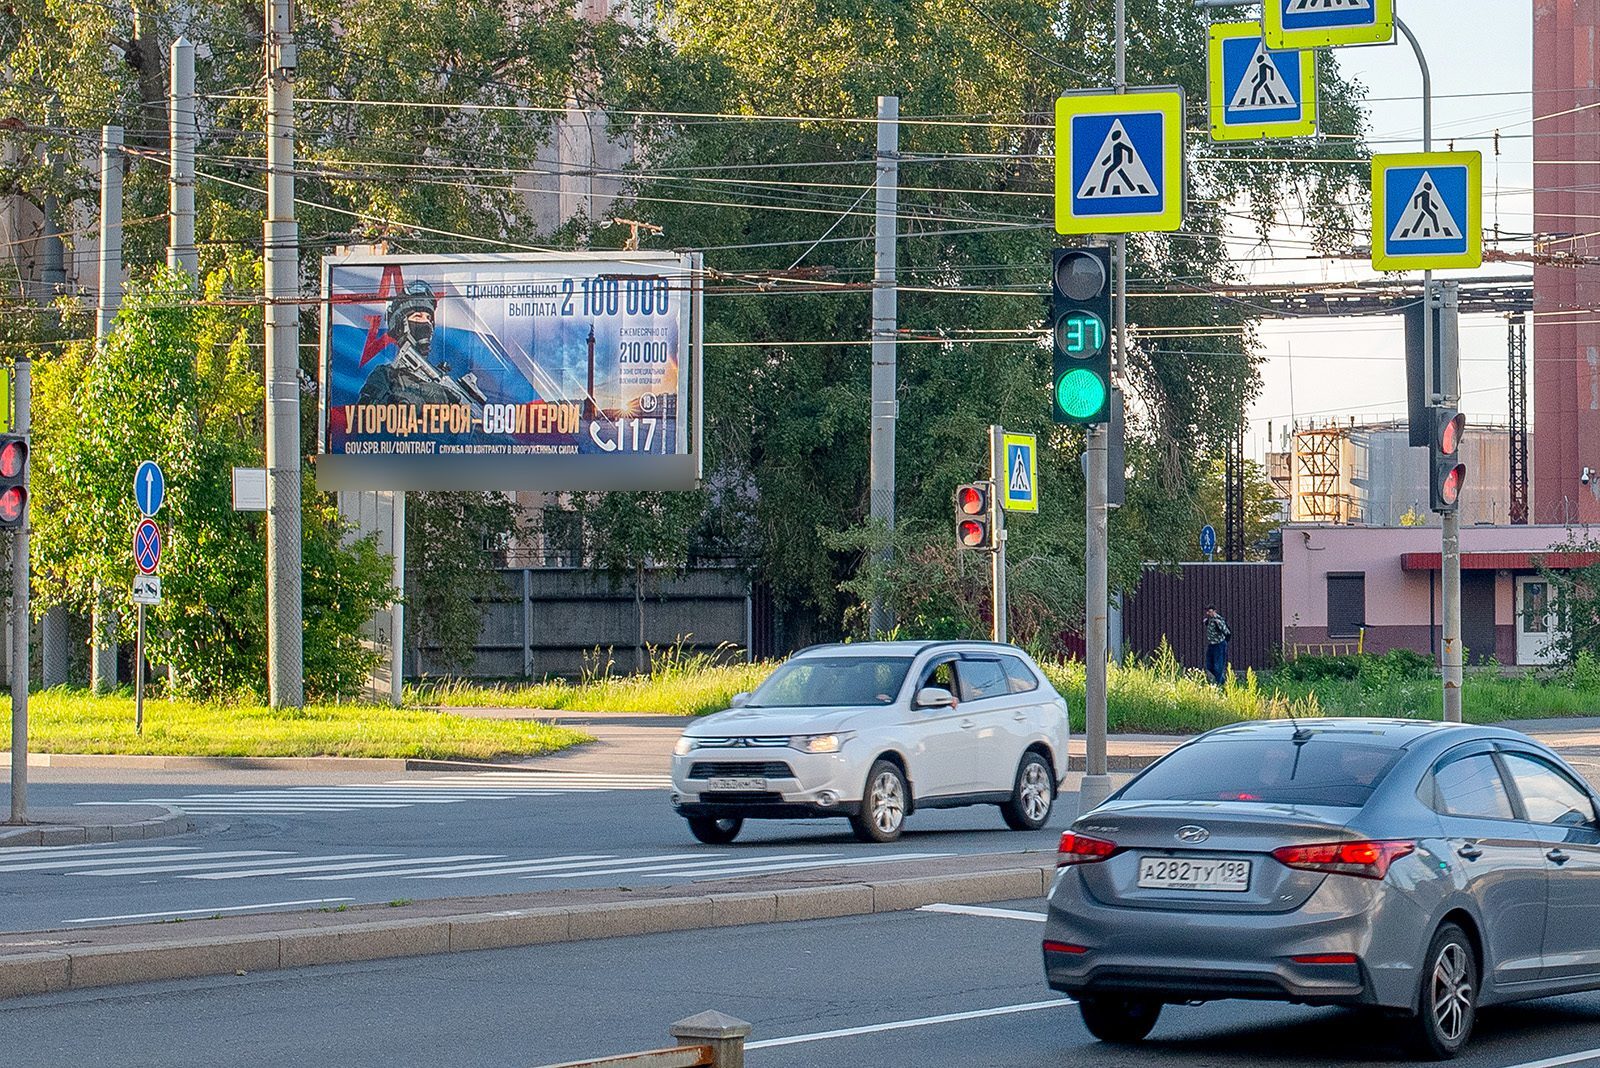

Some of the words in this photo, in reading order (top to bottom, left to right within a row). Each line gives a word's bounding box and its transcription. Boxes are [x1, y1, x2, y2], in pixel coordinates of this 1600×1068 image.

[466, 285, 557, 299] ЕДИНОВРЕМЕННАЯ
[561, 278, 574, 315] 2
[509, 302, 557, 316] ВЫПЛАТА
[1067, 319, 1100, 351] 37
[620, 342, 640, 363] 210
[644, 342, 667, 363] 000
[345, 404, 355, 434] У
[529, 403, 580, 434] ГЕРОИ
[615, 418, 657, 451] 117
